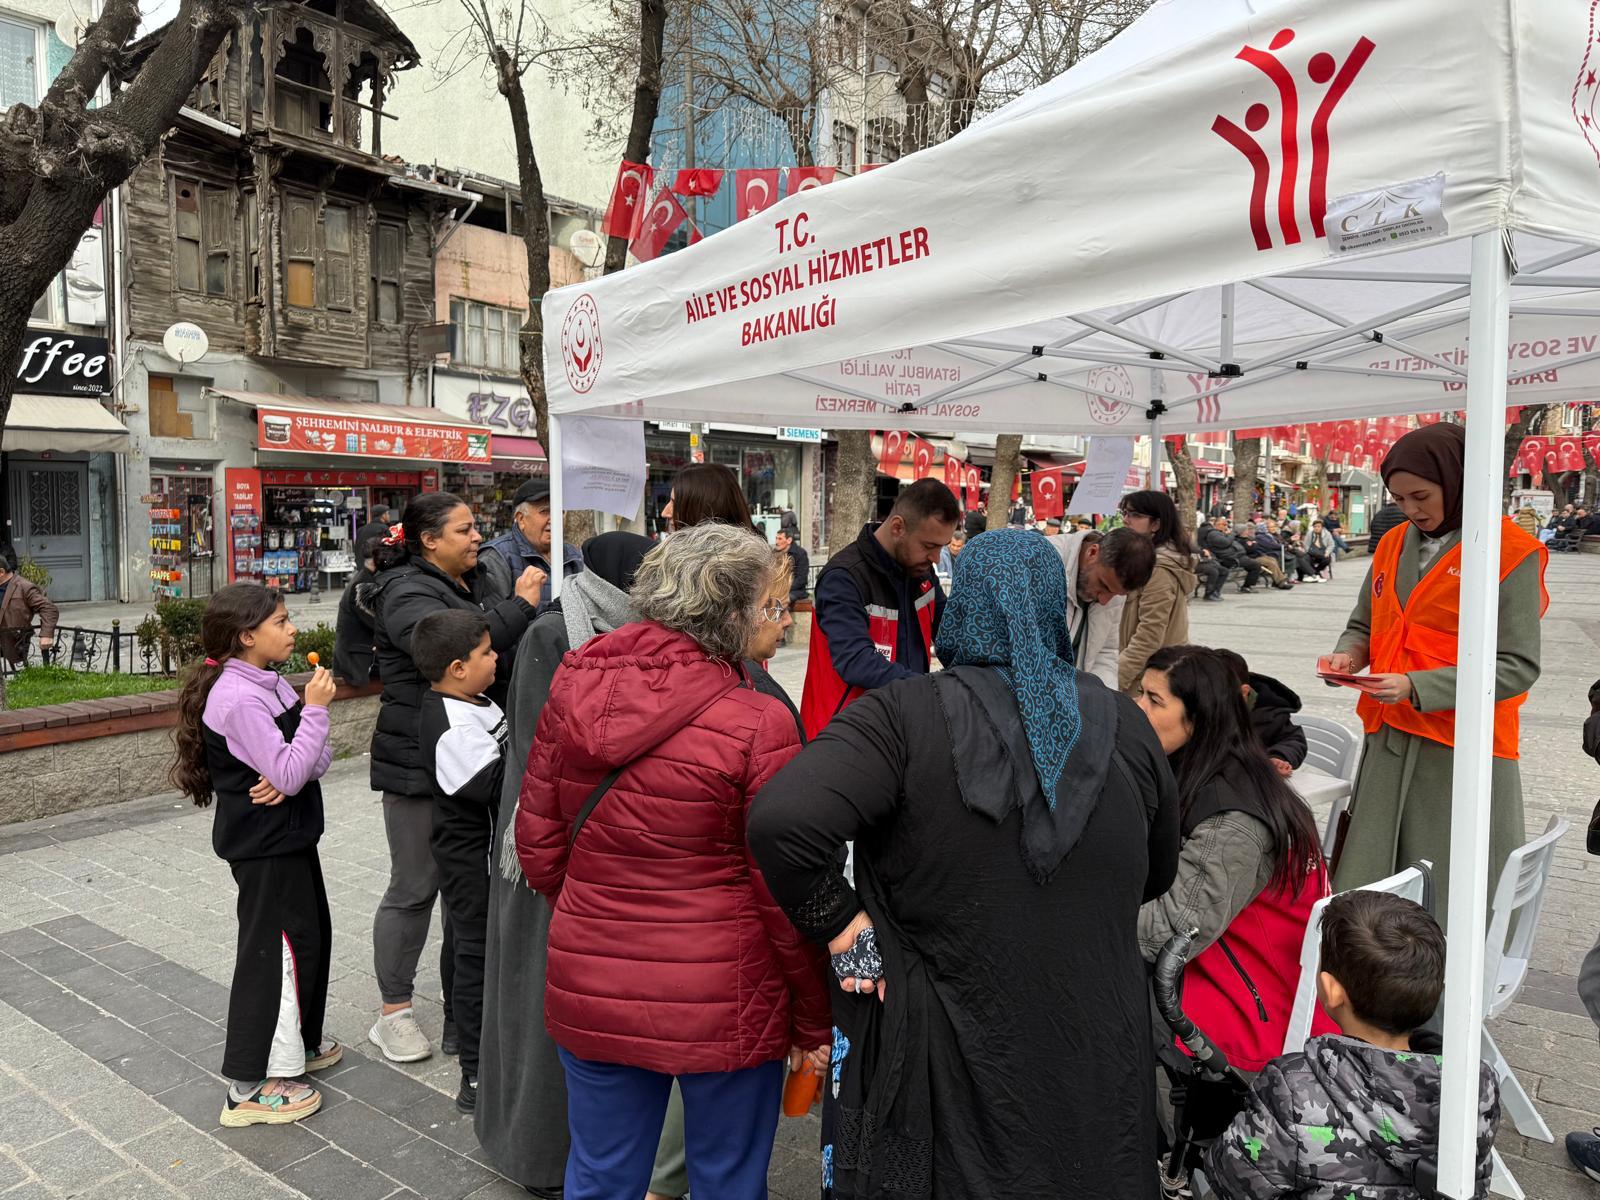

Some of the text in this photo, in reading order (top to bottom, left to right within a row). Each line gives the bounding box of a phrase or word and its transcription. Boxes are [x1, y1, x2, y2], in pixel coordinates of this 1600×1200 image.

[775, 212, 816, 254] T.C.
[685, 226, 930, 324] AİLE VE SOSYAL HİZMETLER
[742, 294, 836, 346] BAKANLIĞI
[73, 384, 103, 392] since 2022
[296, 416, 463, 440] ŞEHREMİNİ NALBUR & ELEKTRİK
[786, 427, 819, 440] SIEMENS
